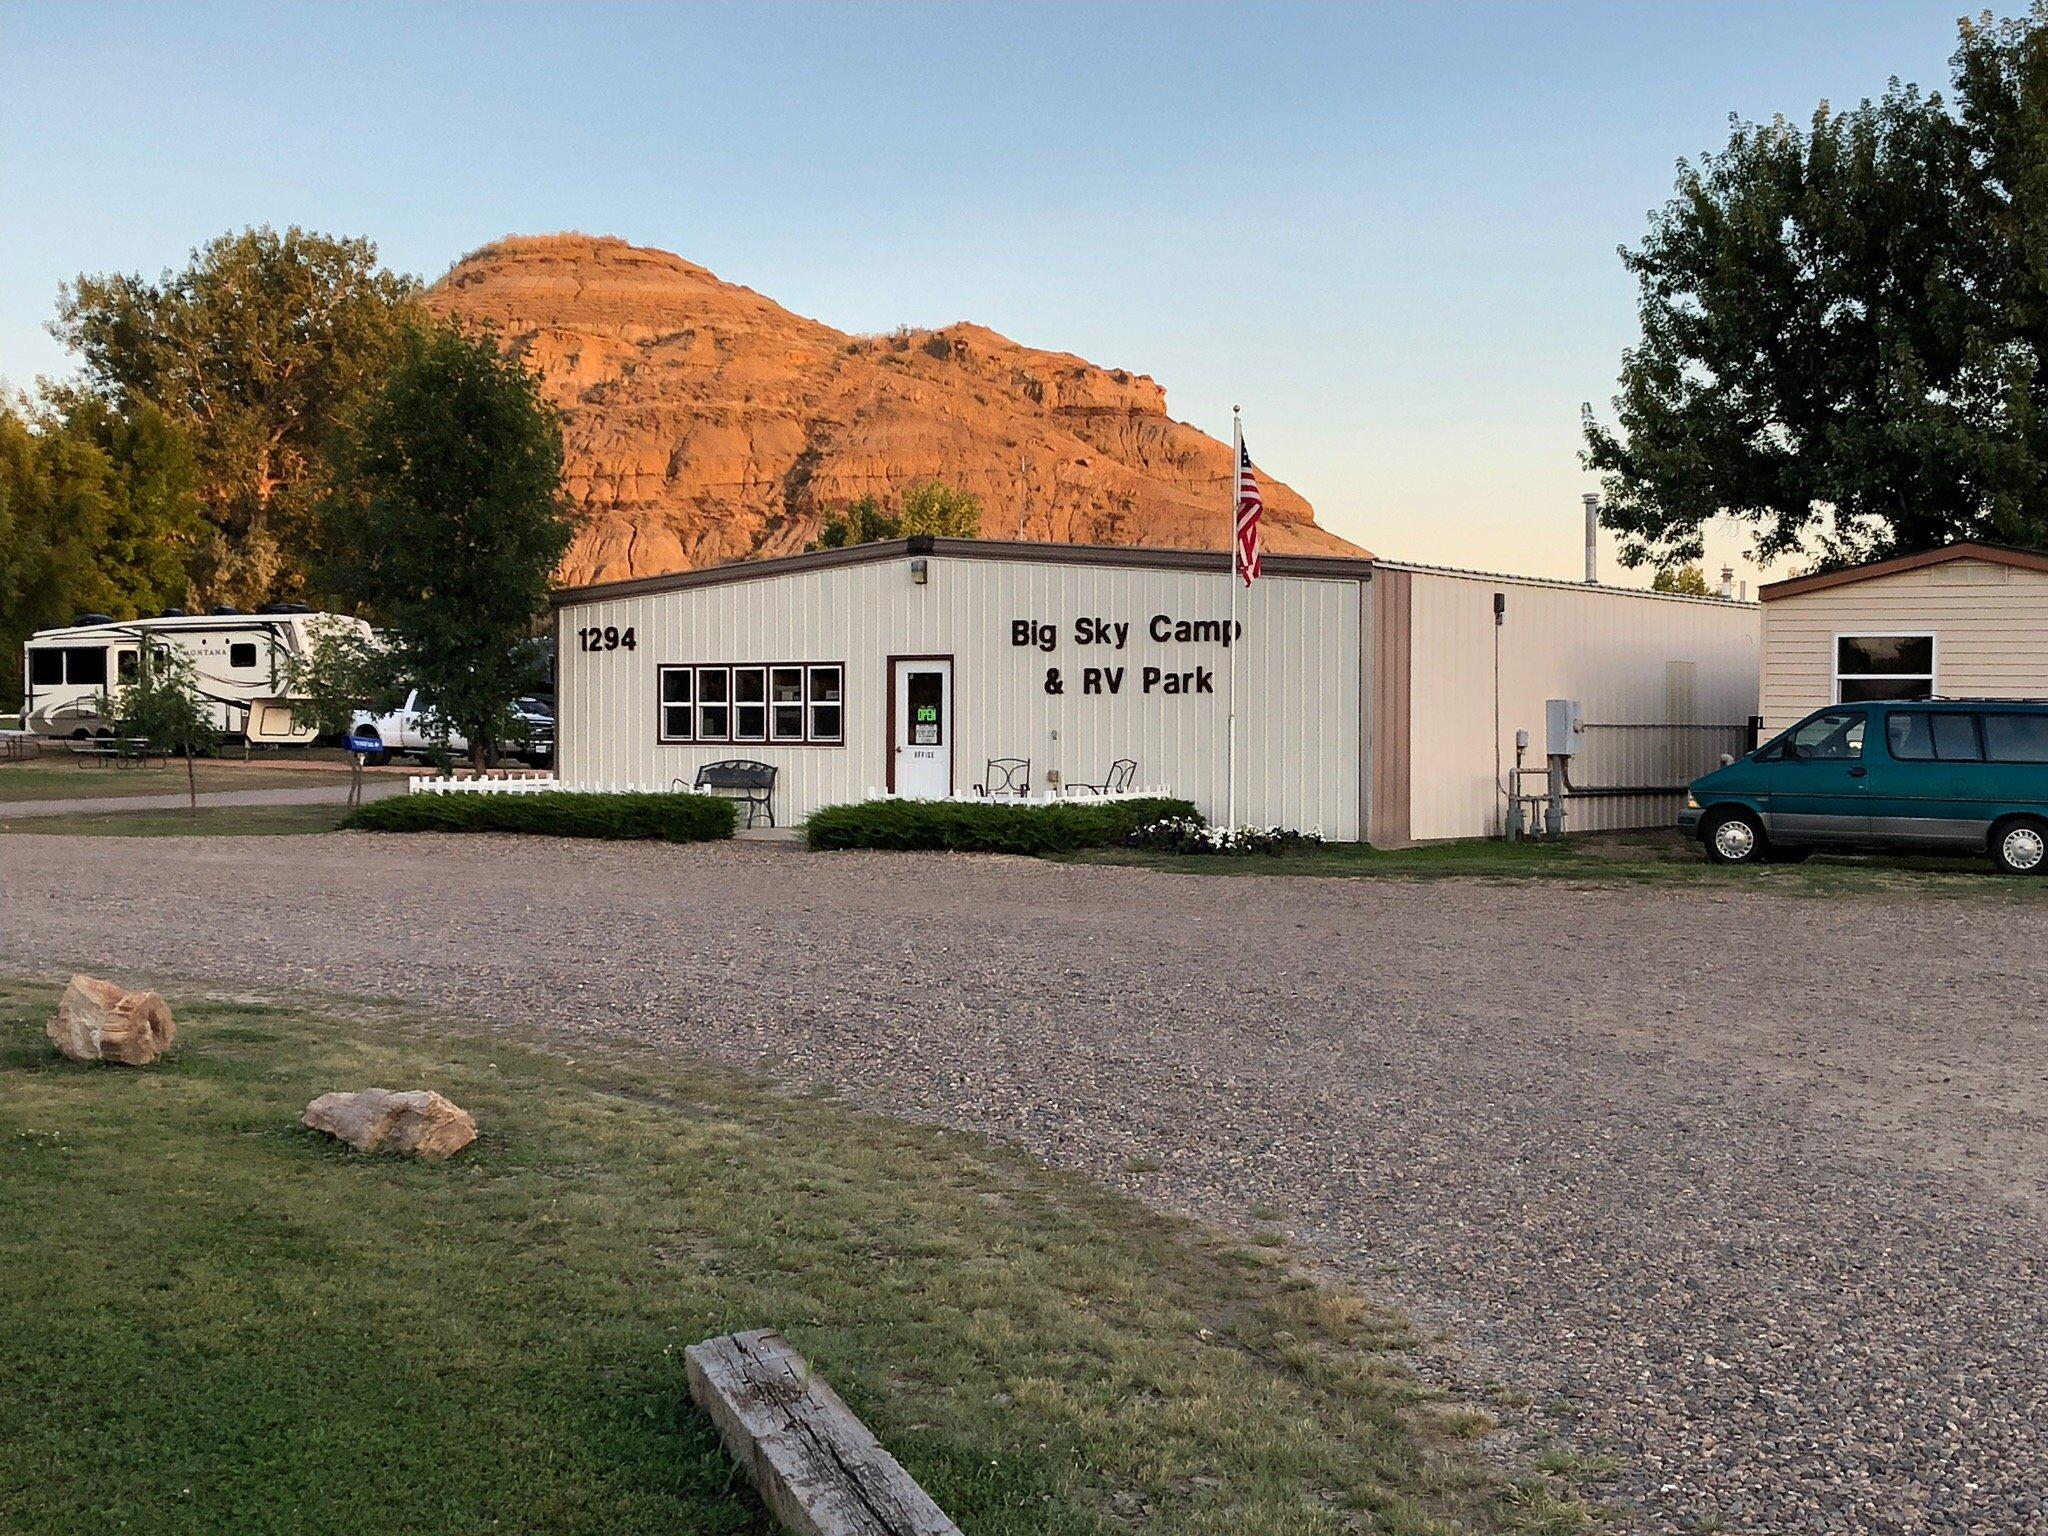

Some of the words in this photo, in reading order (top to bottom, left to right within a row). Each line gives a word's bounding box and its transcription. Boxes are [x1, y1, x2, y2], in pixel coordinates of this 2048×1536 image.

[578, 626, 637, 653] 1294
[1011, 619, 1057, 653] Big
[1074, 617, 1130, 650] Sky
[1149, 614, 1242, 648] Camp
[1043, 667, 1064, 695] &
[1083, 666, 1125, 695] RV
[1142, 665, 1214, 695] Park
[917, 708, 937, 721] OPEN
[914, 751, 935, 759] OFFICE
